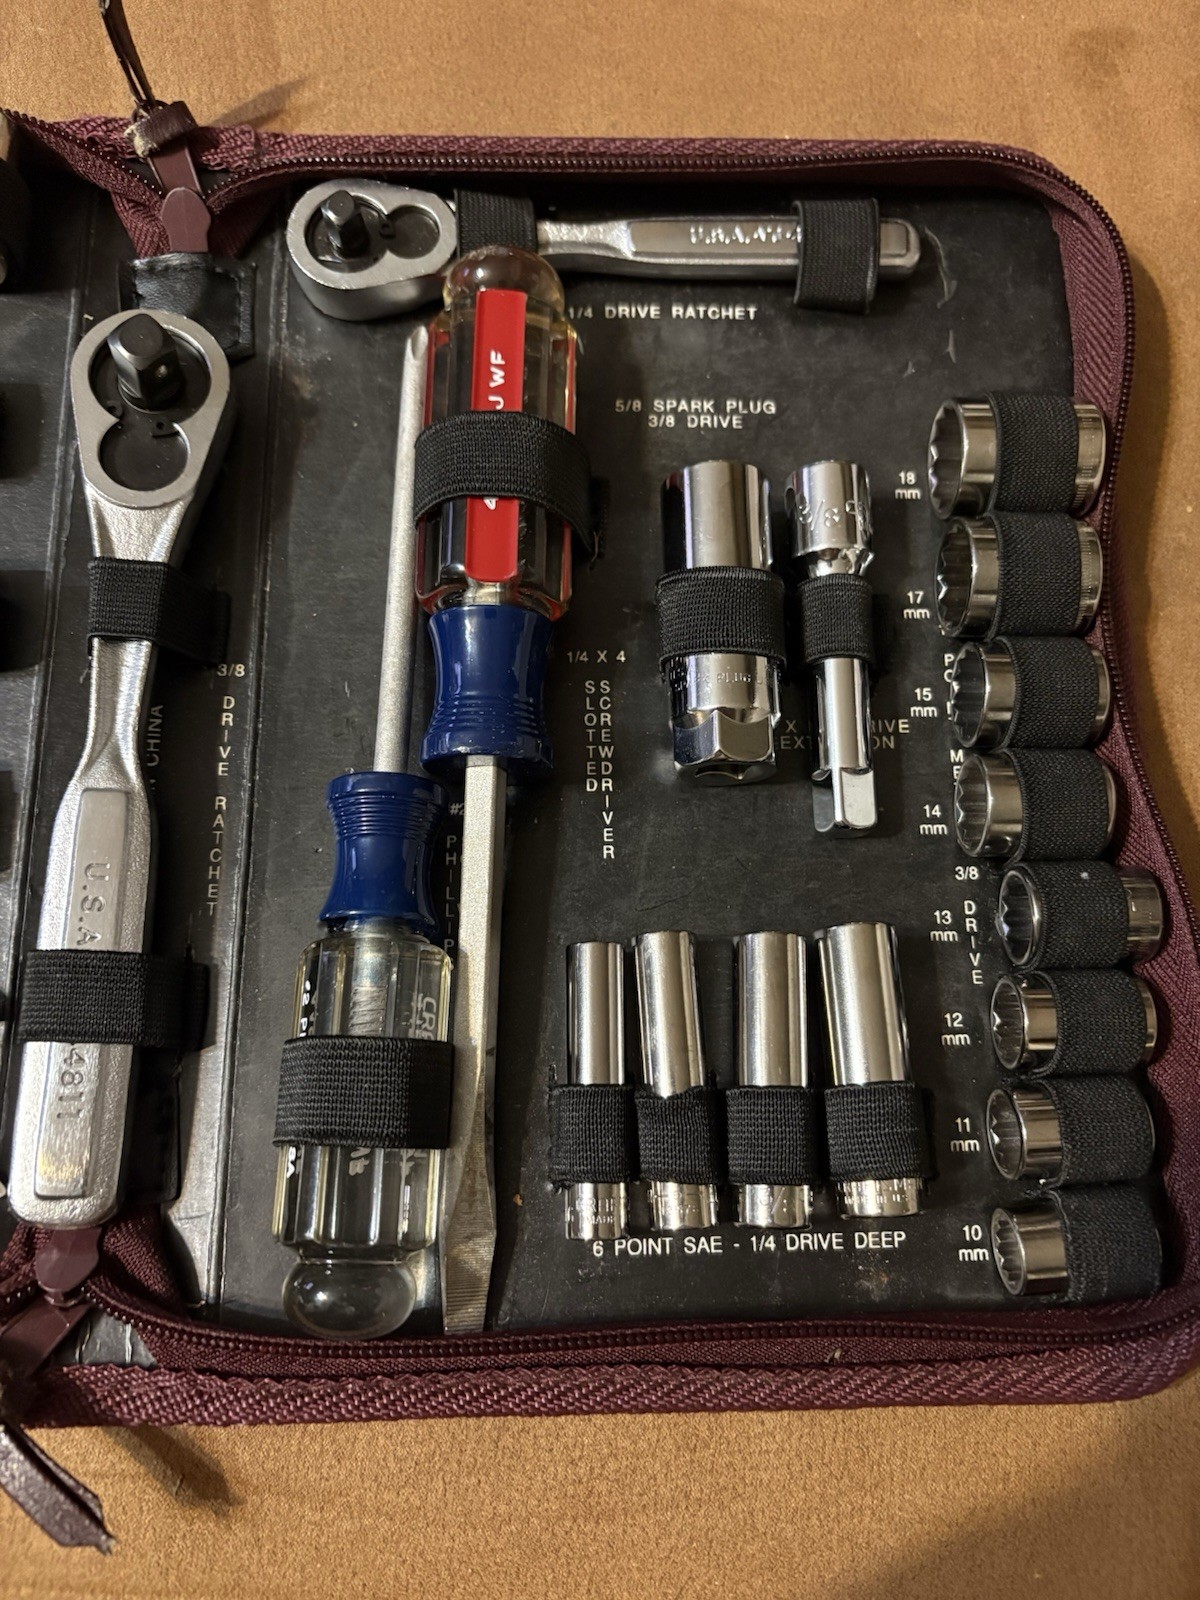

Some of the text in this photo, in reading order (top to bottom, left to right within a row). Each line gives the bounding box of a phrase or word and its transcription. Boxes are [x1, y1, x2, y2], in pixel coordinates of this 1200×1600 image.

[568, 304, 757, 321] 1/4 DRIVE RATCHET
[615, 399, 776, 414] 5/8 SPARK PLUG
[648, 415, 743, 429] 3/8 DRIVE
[899, 470, 916, 484] 18
[895, 488, 921, 500] mm
[907, 590, 924, 604] 17
[903, 608, 930, 619] mm
[567, 650, 626, 664] 1/4 X 4
[217, 663, 245, 678] 3/8
[915, 687, 932, 701] 15
[911, 706, 938, 718] mm
[869, 718, 910, 734] RIVE
[146, 704, 164, 767] CHINA
[217, 696, 235, 776] DRIVE
[585, 680, 598, 793] SLOTTED
[599, 680, 615, 860] SCREWDRIVER
[923, 805, 941, 818] 14
[919, 823, 948, 835] mm
[206, 796, 227, 916] RATCHET
[954, 865, 979, 880] 3/8
[933, 910, 952, 925] 13
[930, 930, 958, 942] mm
[963, 900, 984, 985] DRIVE
[944, 1012, 964, 1028] 12
[941, 1033, 971, 1046] mm
[955, 1117, 971, 1133] 11
[950, 1139, 980, 1152] mm
[963, 1225, 982, 1241] 10
[592, 1240, 604, 1258] 6
[614, 1236, 674, 1257] POINT
[683, 1235, 723, 1255] SAE
[751, 1234, 776, 1252] 1/4
[785, 1232, 844, 1251] DRIVE
[854, 1230, 907, 1249] DEEP
[958, 1247, 989, 1262] mm
